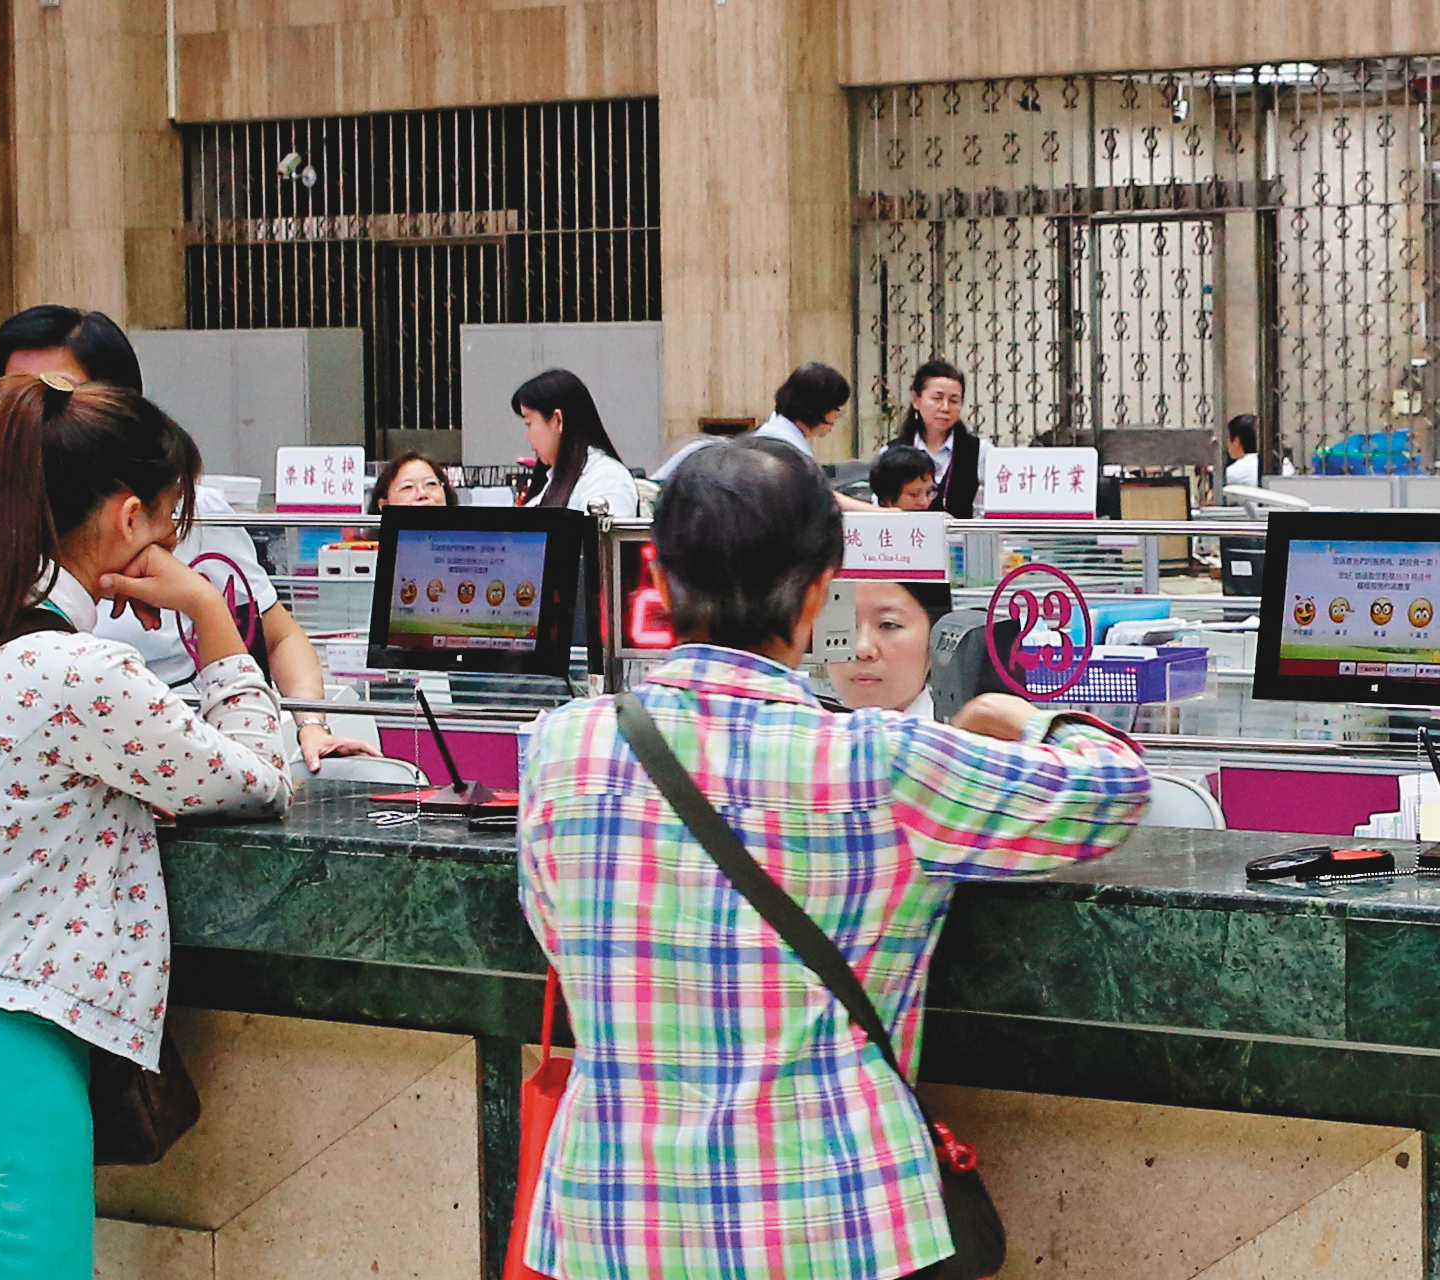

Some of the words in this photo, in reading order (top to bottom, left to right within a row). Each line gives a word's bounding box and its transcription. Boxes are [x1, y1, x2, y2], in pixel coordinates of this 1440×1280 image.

[995, 463, 1086, 494] 會計作業
[1008, 589, 1074, 671] 23
